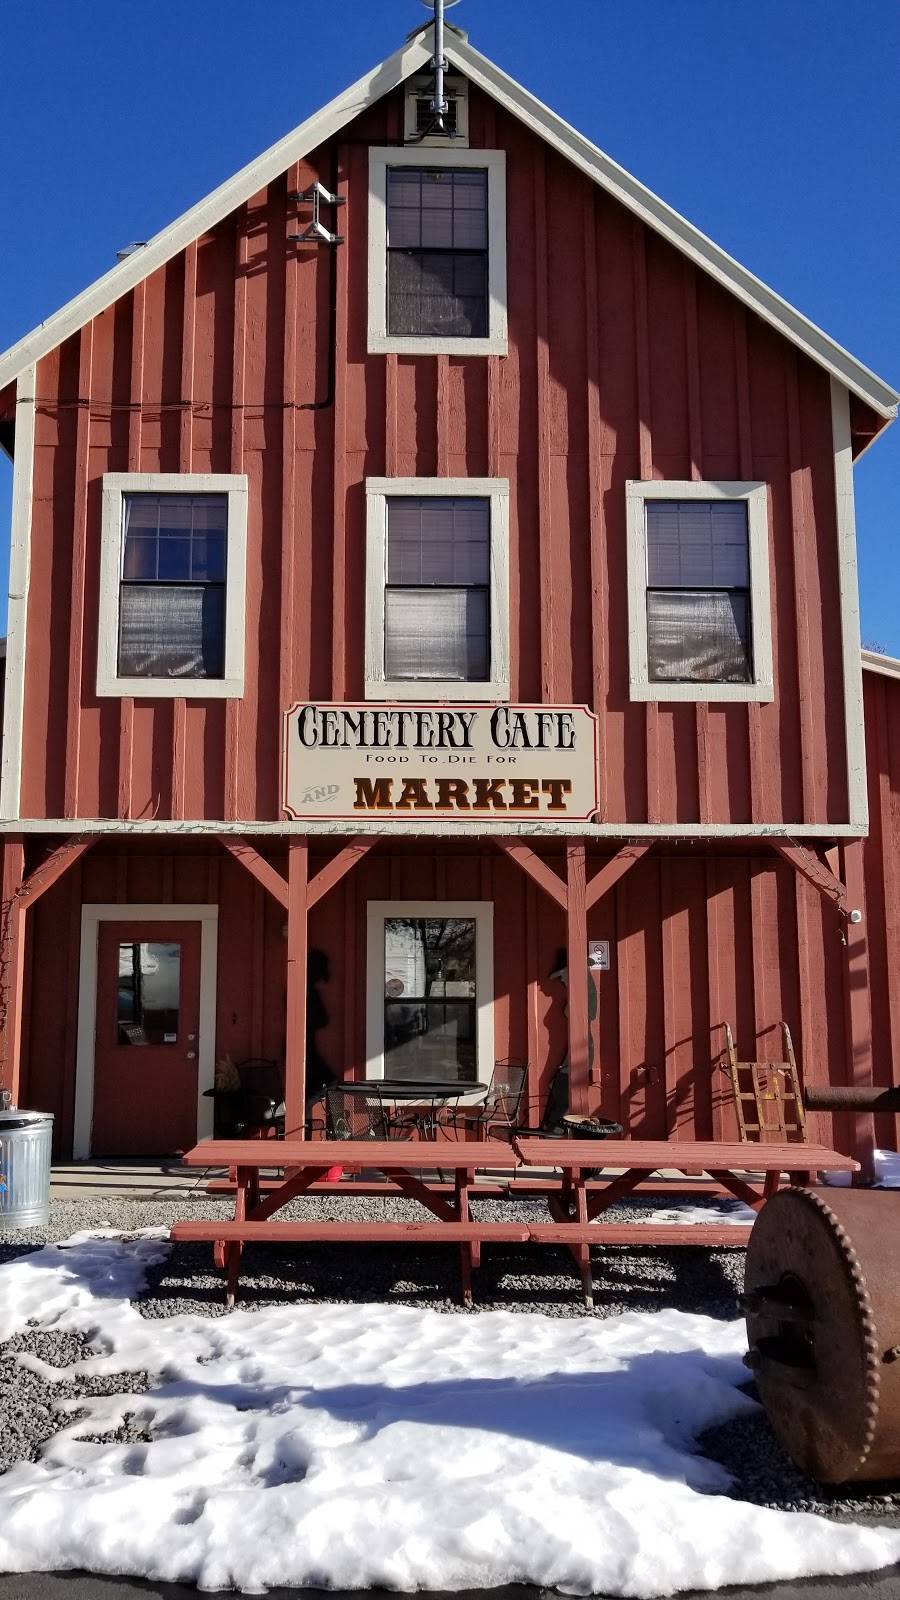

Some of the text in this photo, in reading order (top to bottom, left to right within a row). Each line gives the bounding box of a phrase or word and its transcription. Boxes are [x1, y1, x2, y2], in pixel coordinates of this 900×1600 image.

[298, 705, 576, 750] CEMETERY CAFE
[366, 754, 517, 763] FOOD TO DIE FOR
[301, 777, 572, 810] AND MARKET
